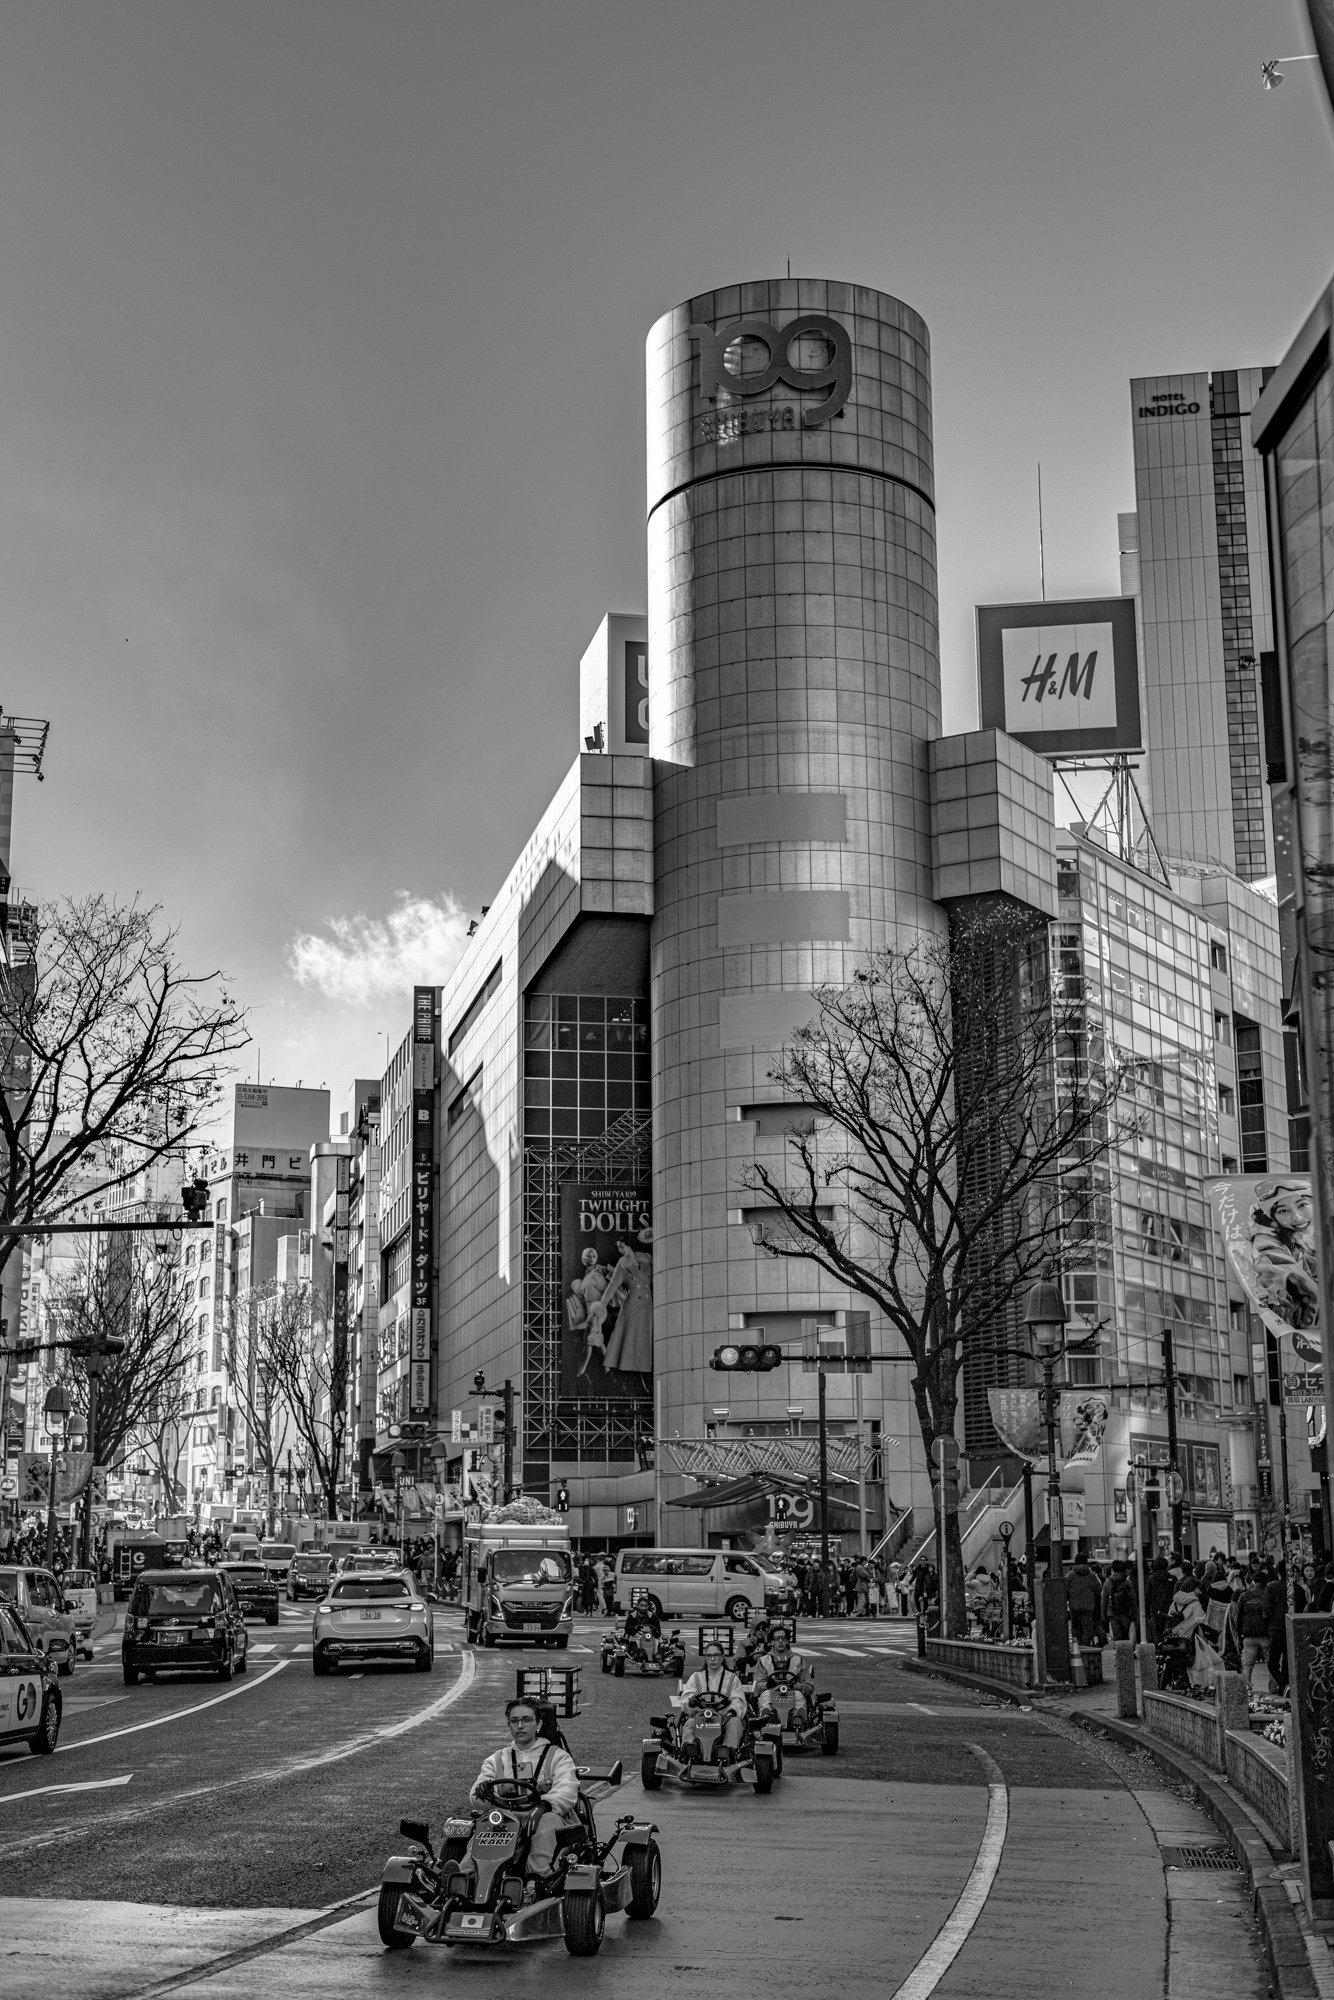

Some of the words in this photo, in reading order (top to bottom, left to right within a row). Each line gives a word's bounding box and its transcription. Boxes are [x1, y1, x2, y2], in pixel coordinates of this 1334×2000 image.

[688, 314, 852, 426] 109
[1152, 393, 1186, 402] HOTEL
[1139, 402, 1200, 418] INDIGO
[1020, 650, 1098, 703] H&M
[417, 994, 431, 1010] THE
[417, 1012, 431, 1041] PRIME
[579, 1199, 649, 1212] TWILIGHT
[579, 1212, 650, 1232] DOLLS
[416, 1172, 430, 1295] ビリヤード・ダーツ
[416, 1297, 427, 1306] 3F
[770, 1521, 798, 1529] SHIBUYA
[17, 1682, 36, 1721] GO
[476, 1831, 516, 1840] JAPAN
